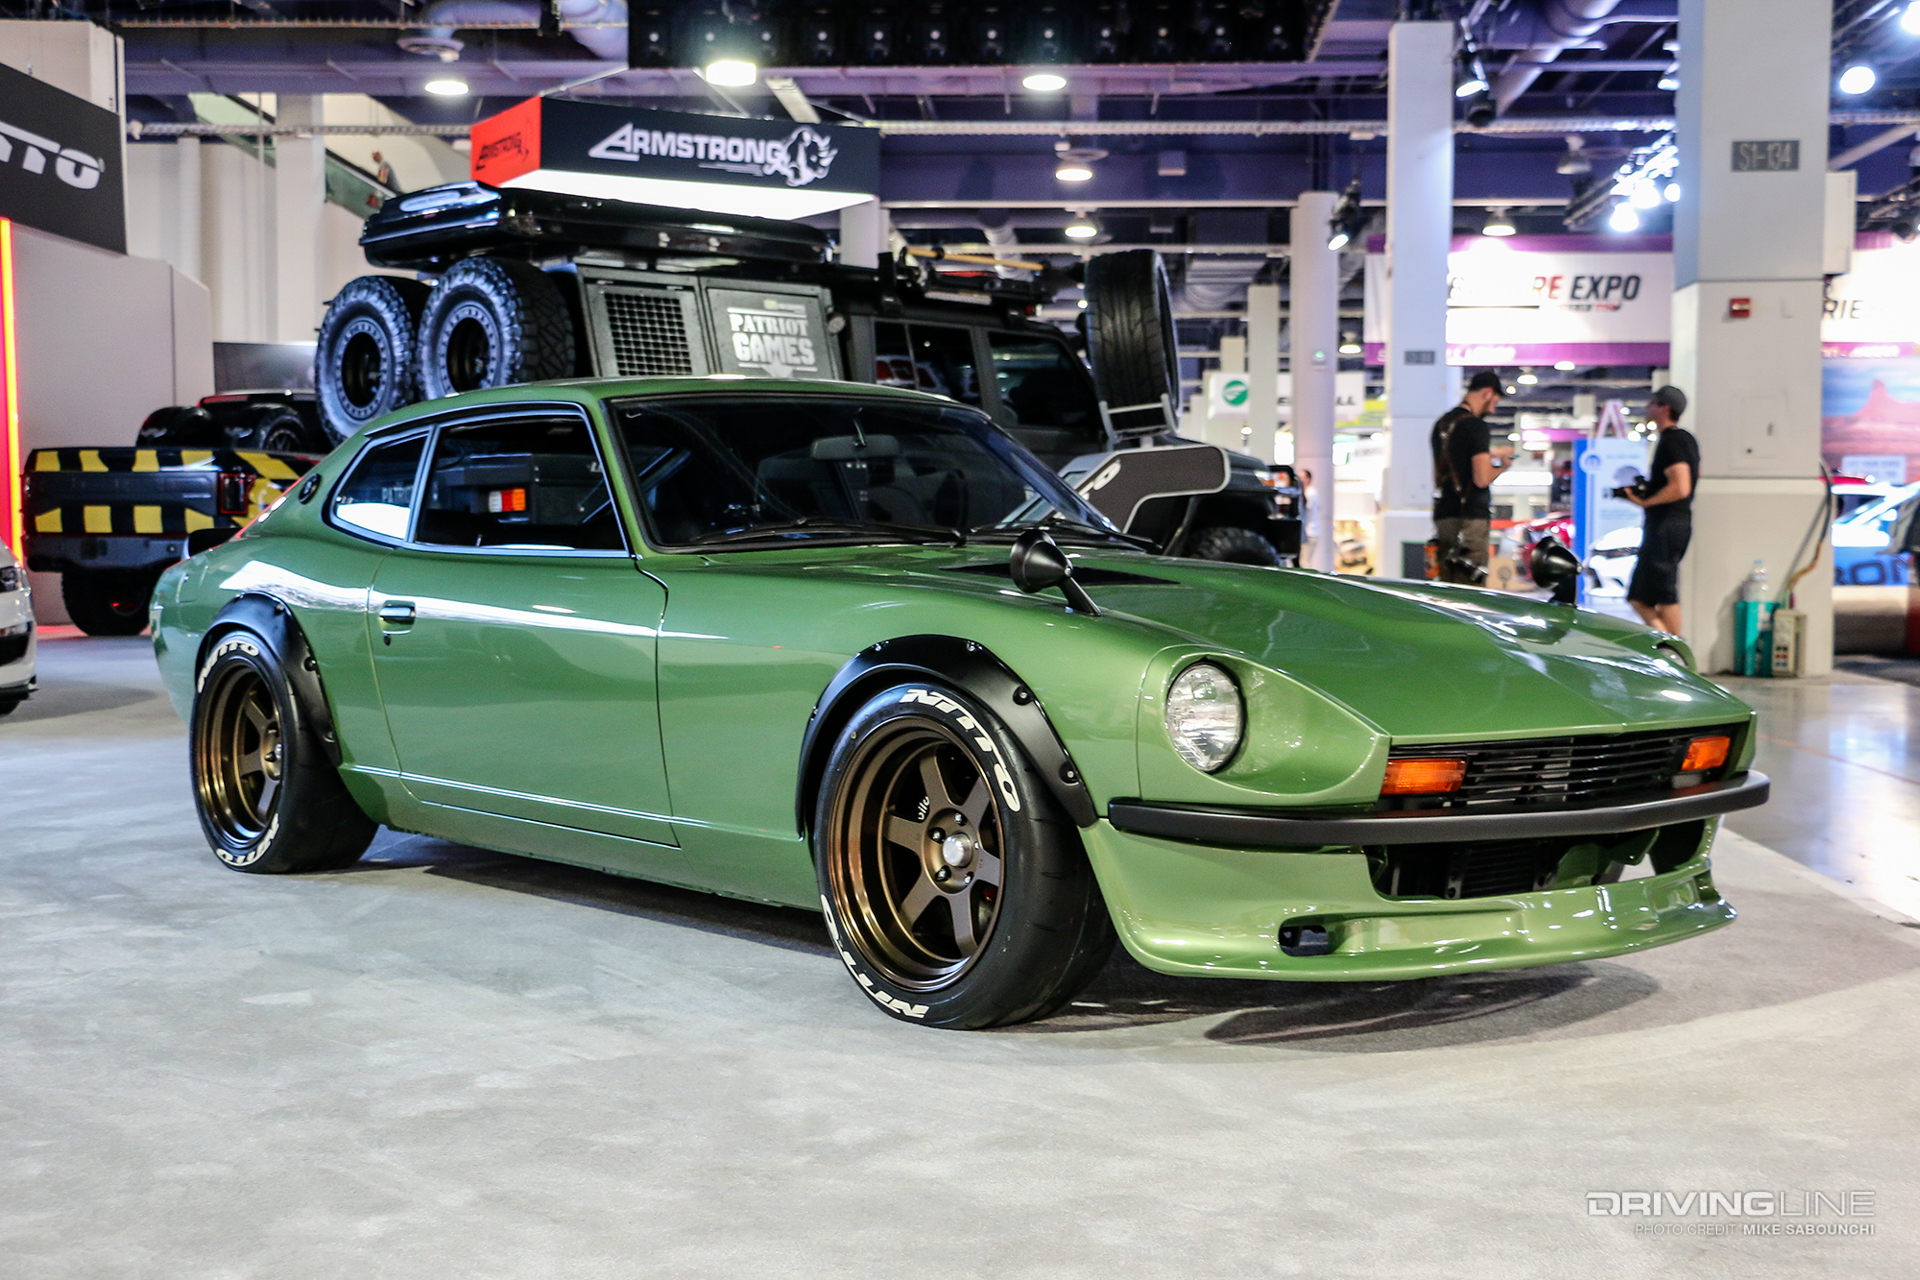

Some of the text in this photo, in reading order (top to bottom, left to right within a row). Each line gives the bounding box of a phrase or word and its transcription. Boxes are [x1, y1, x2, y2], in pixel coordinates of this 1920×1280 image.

[588, 122, 785, 166] ARMSTRONG
[1570, 275, 1641, 300] EXPO
[729, 313, 808, 337] PATRIOT
[732, 332, 816, 366] GAMES
[899, 689, 1021, 812] NITTO
[820, 894, 930, 1019] NITTO
